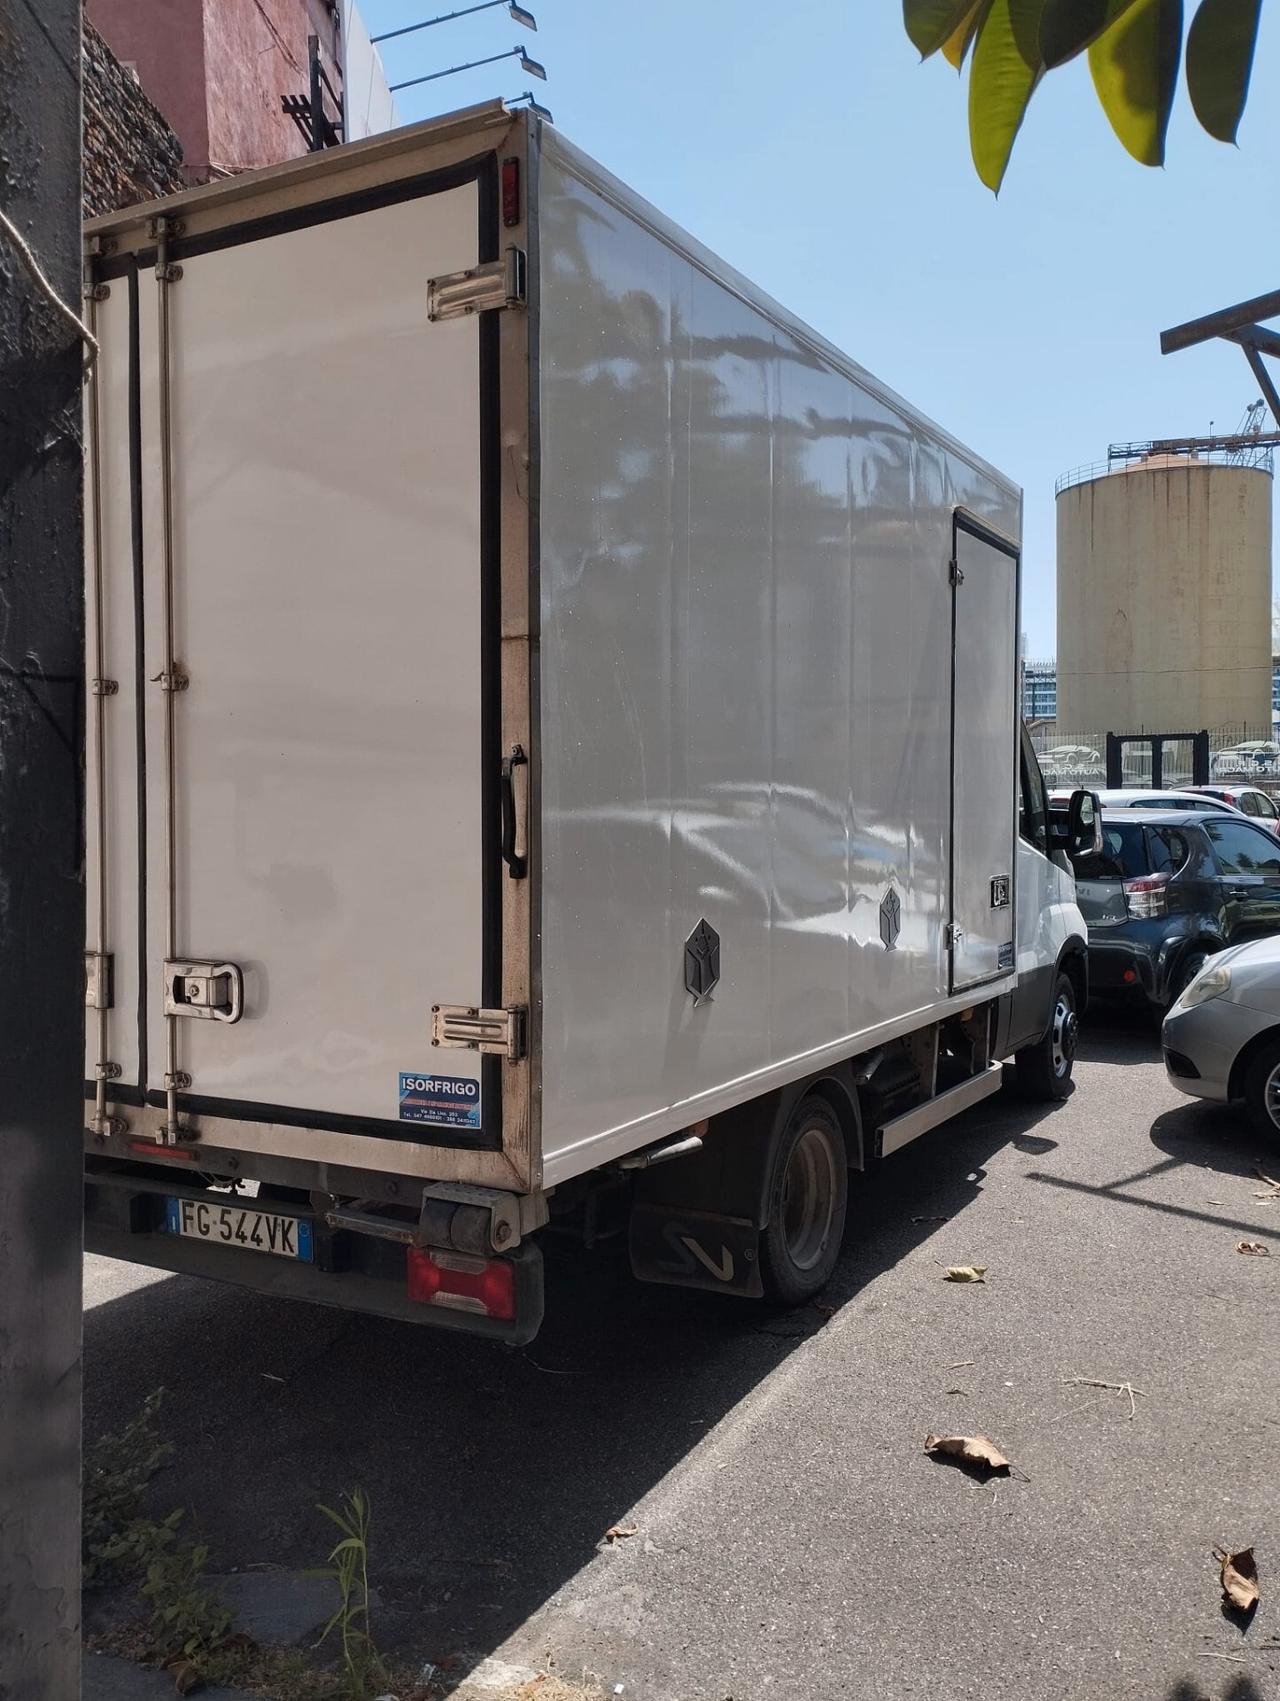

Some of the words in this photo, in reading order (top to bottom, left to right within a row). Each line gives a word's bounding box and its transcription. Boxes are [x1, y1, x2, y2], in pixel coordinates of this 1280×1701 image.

[402, 1078, 476, 1096] ISORFRIGO
[181, 1201, 210, 1236] FG
[220, 1208, 295, 1254] 544VK
